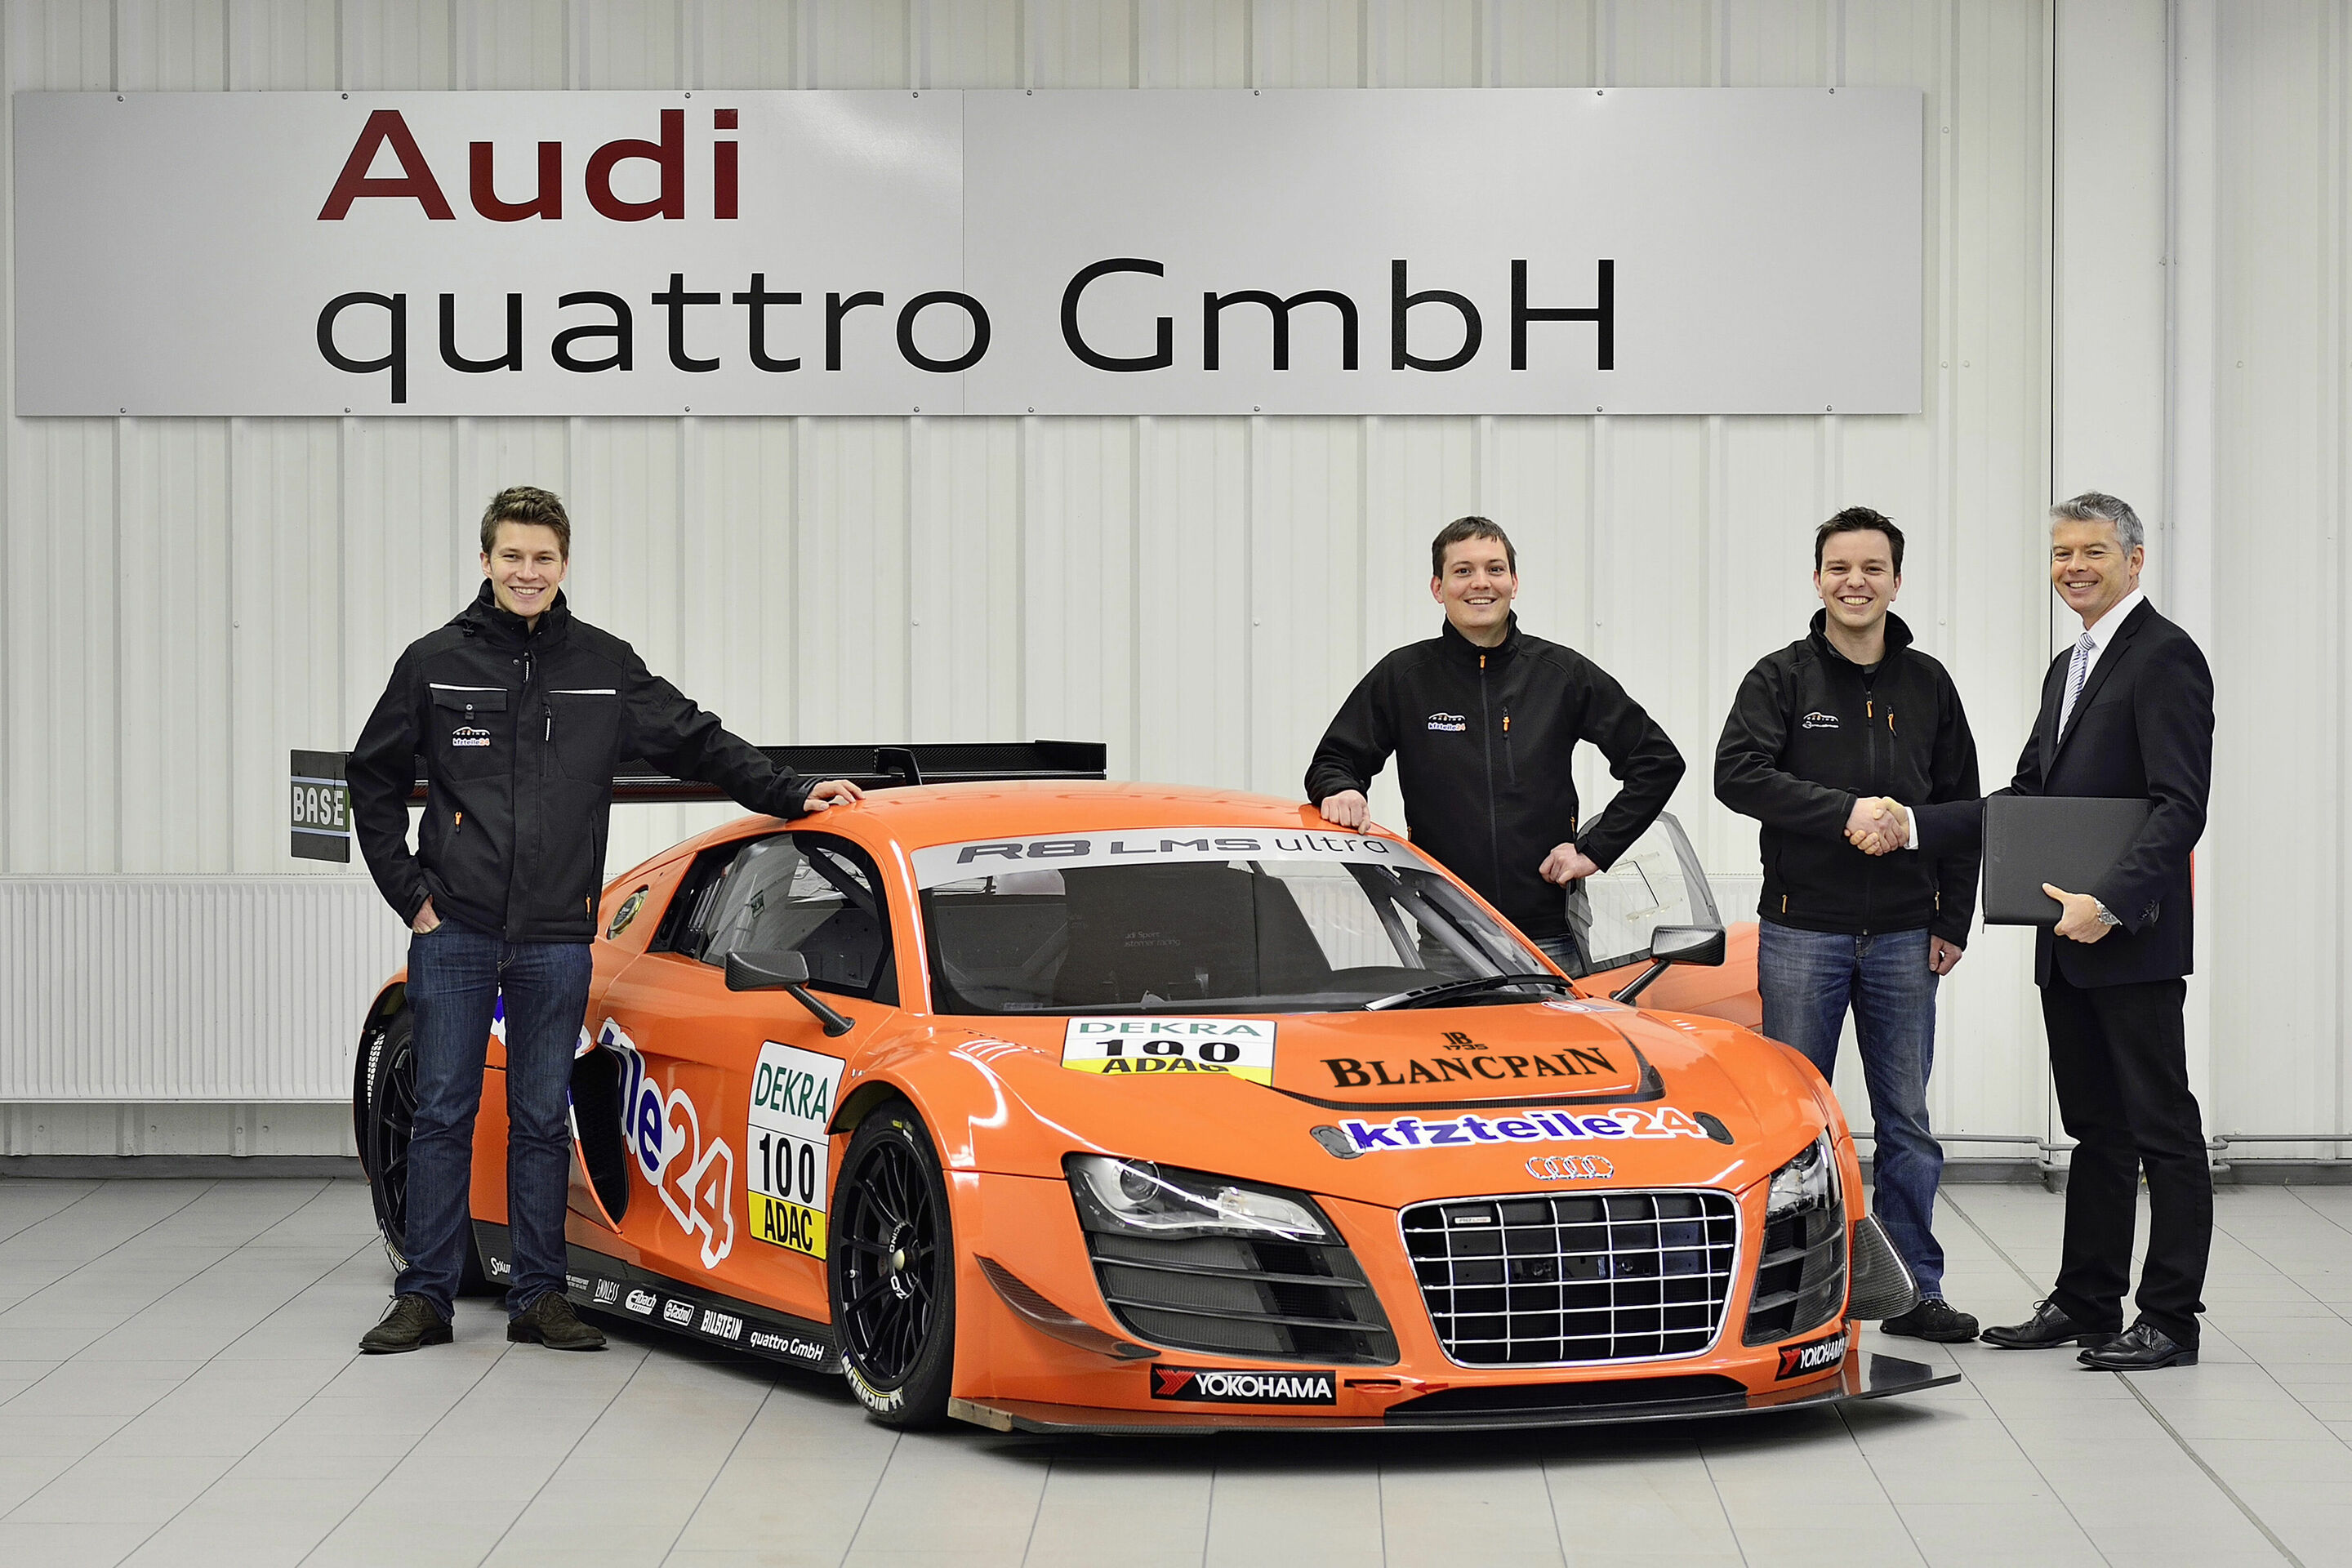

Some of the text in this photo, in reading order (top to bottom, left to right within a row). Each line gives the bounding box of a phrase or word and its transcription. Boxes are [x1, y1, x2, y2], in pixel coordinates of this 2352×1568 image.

[316, 108, 739, 221] Audi
[315, 257, 1615, 404] quattro GmbH
[293, 786, 344, 826] BASE
[956, 834, 1390, 864] R8 LMS ultra
[1079, 1022, 1263, 1037] DEKRA
[1095, 1039, 1241, 1063] 100
[1319, 1047, 1619, 1089] BLANCPAIN
[754, 1062, 828, 1125] DEKRA
[1343, 1108, 1708, 1152] kfzteile24
[759, 1132, 816, 1205] 100
[764, 1198, 813, 1253] ADAC
[700, 1309, 743, 1341] BILSTEIN
[750, 1331, 825, 1361] quattro GmbH
[1799, 1337, 1846, 1370] YOKOHAMA
[841, 1355, 889, 1412] MICHELIN
[1195, 1374, 1333, 1398] YOKOHAMA
